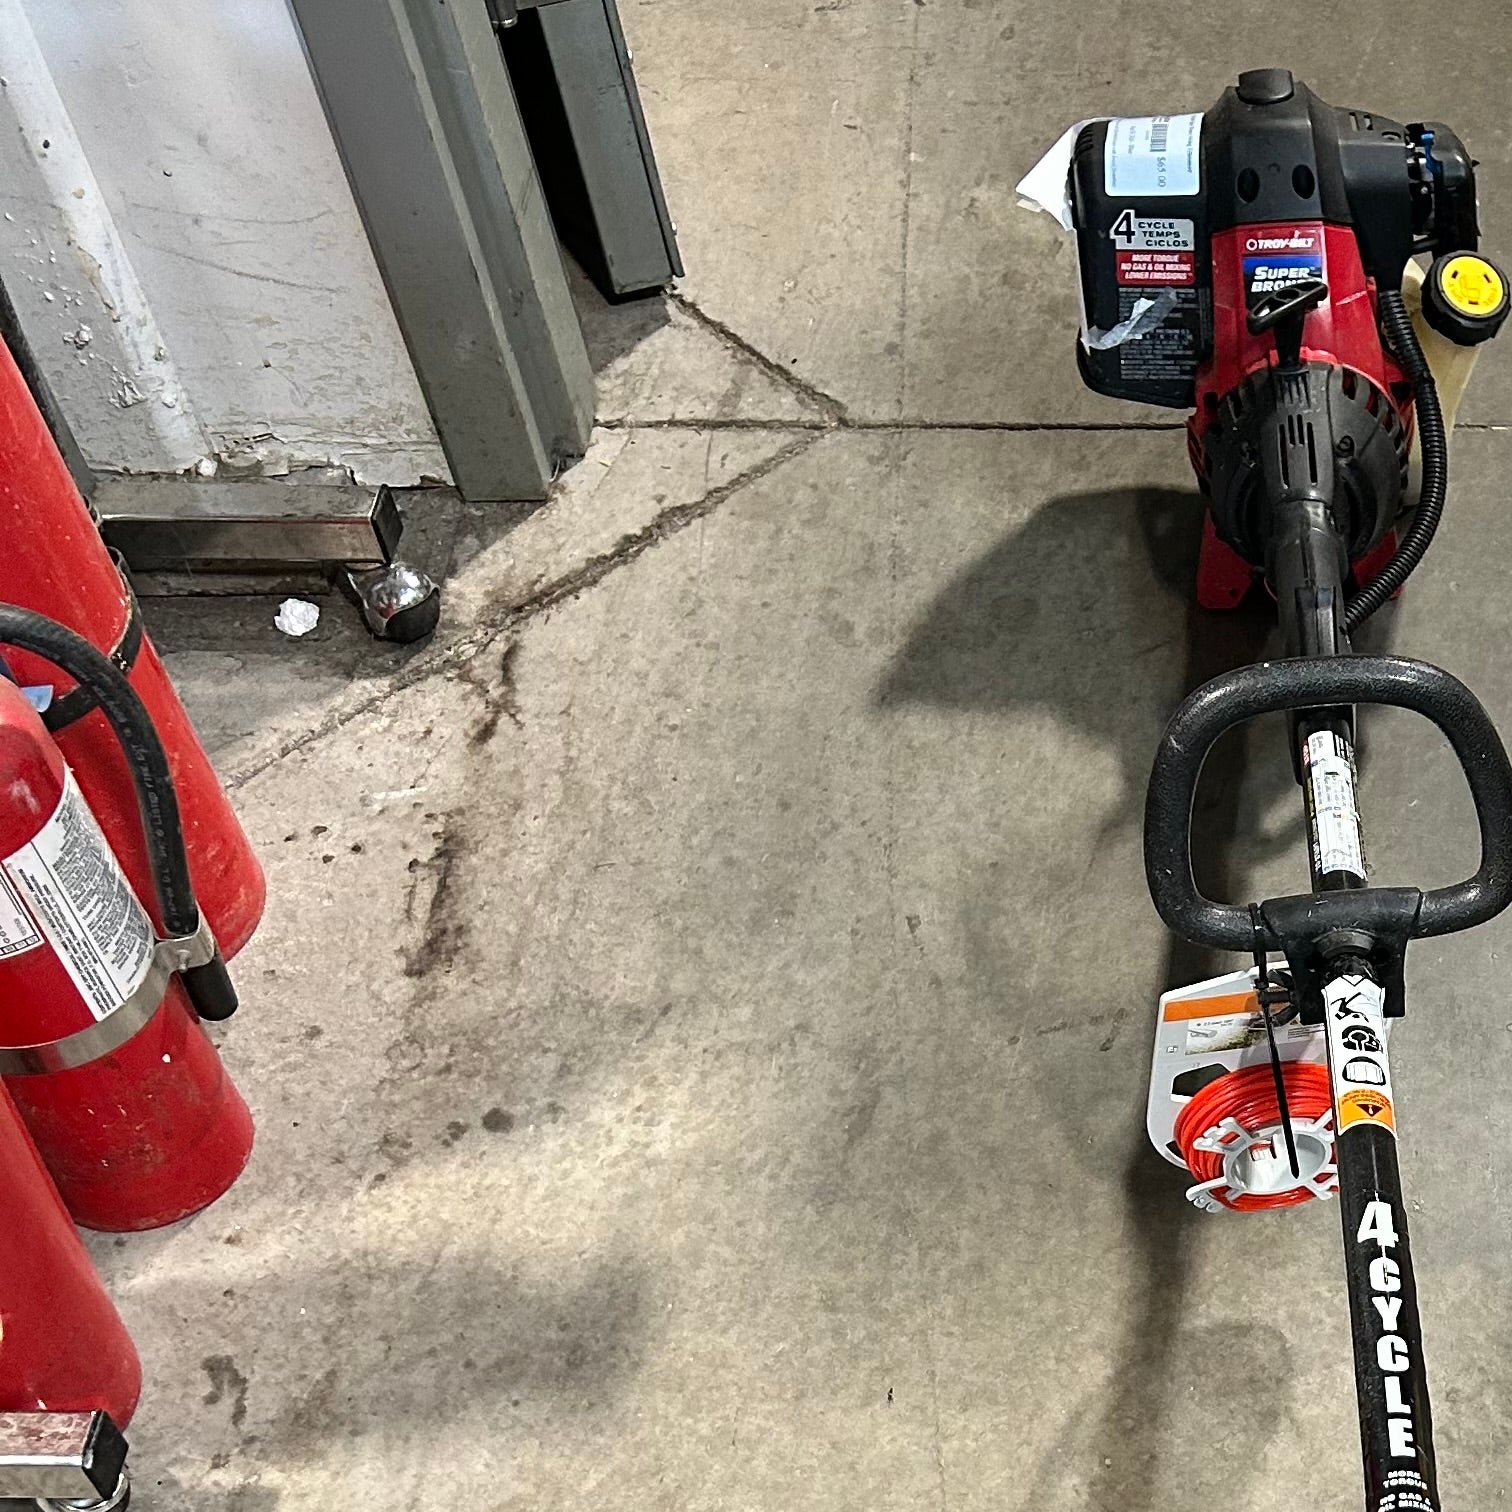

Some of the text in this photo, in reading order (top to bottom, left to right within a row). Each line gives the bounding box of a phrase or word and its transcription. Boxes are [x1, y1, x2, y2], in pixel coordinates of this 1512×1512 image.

[1114, 211, 1136, 244] 4
[1138, 221, 1175, 229] CYCLE
[1142, 230, 1181, 239] TEMPS
[1145, 239, 1189, 247] CICLOS
[1254, 266, 1310, 280] SUPER
[1357, 1201, 1416, 1458] 4 CYCLE
[1387, 1470, 1421, 1480] MORE
[1382, 1477, 1428, 1490] TORQUE
[1379, 1493, 1396, 1506] NO
[1398, 1492, 1422, 1502] GAS
